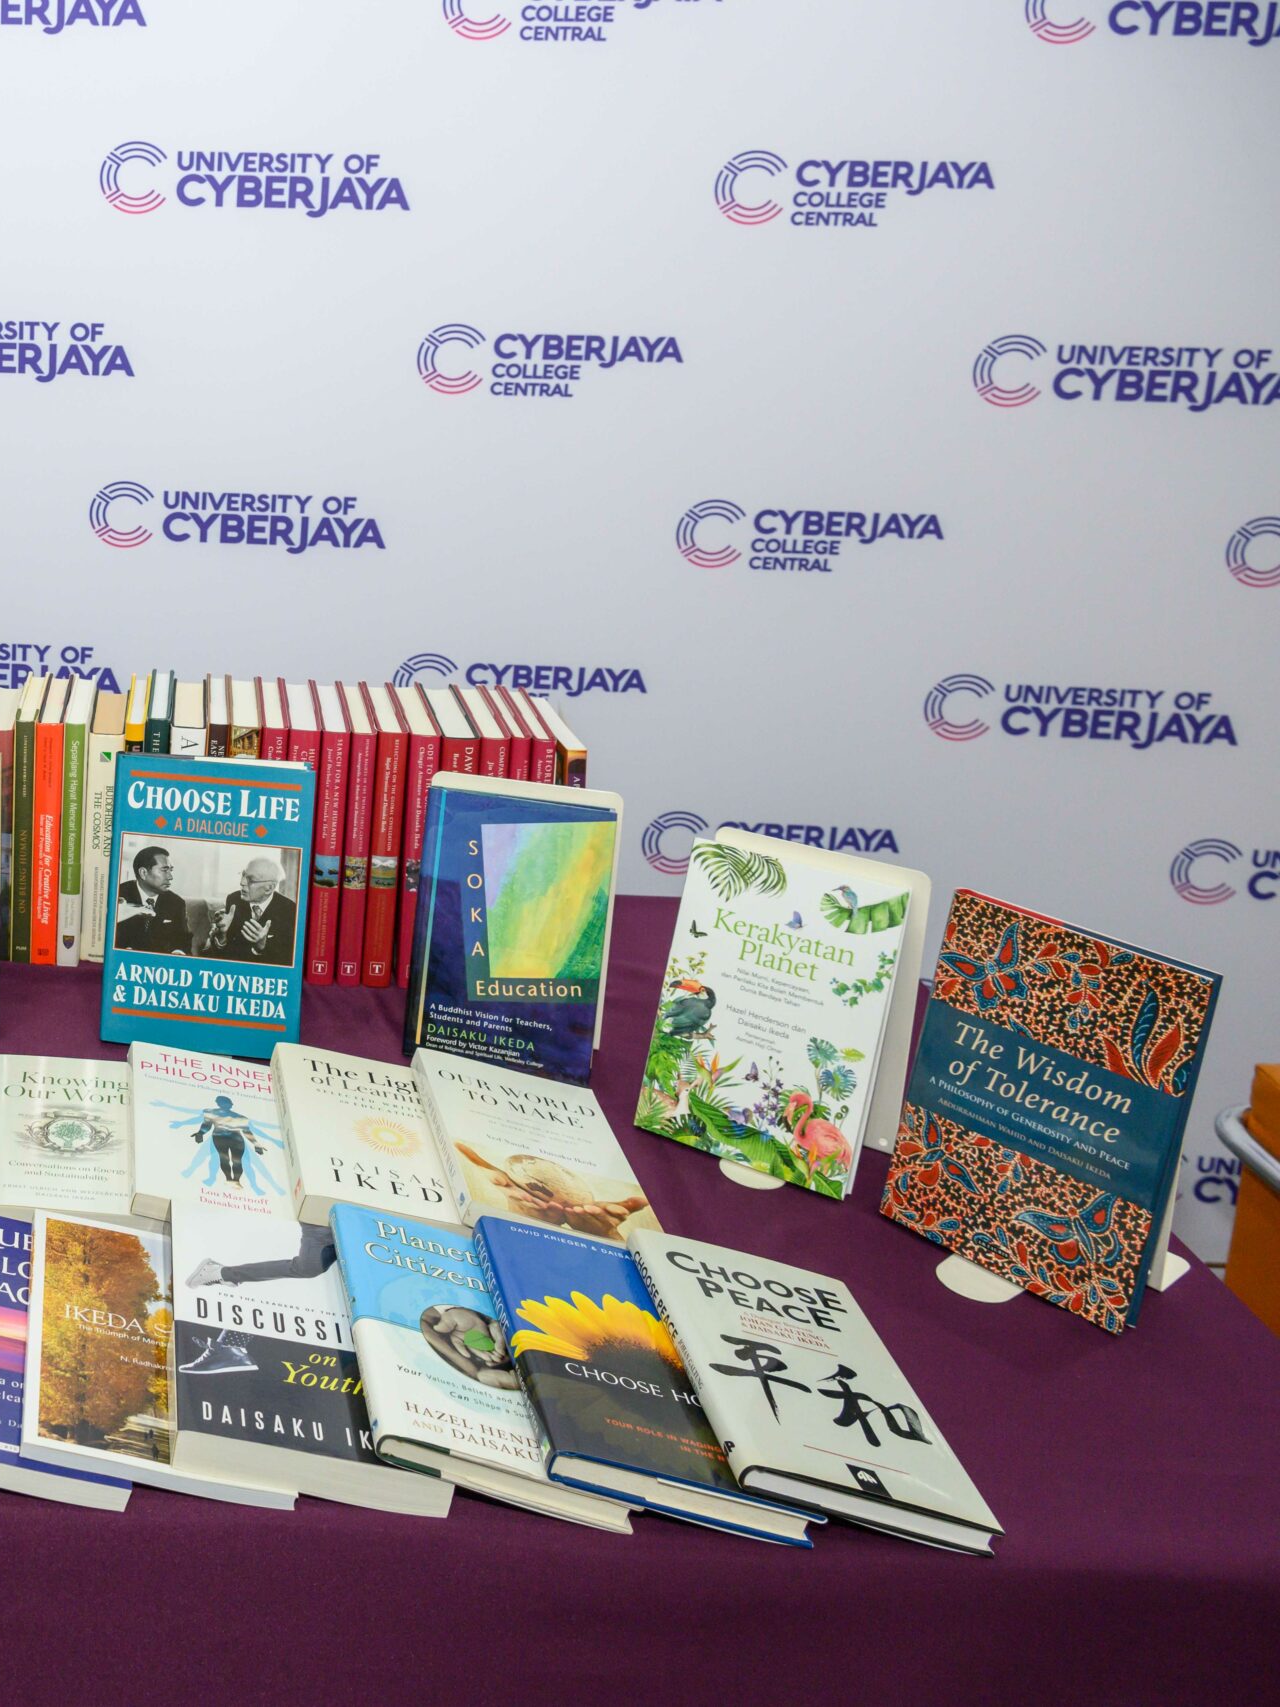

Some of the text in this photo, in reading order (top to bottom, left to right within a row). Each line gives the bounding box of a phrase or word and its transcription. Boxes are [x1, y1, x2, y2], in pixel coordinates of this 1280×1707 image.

[177, 151, 381, 176] UNIVERSITY OF
[795, 160, 995, 196] CYBERJAYA
[176, 174, 410, 218] CYBERJAYA
[792, 192, 886, 208] COLLEGE
[790, 211, 878, 227] CENTRAL
[69, 323, 104, 341] OF
[492, 333, 683, 370] CYBERJAYA
[1057, 345, 1272, 369] UNIVERSITY OF
[491, 364, 580, 380] COLLEGE
[490, 382, 573, 397] CENTRAL
[162, 490, 357, 515] UNIVERSITY OF
[162, 510, 386, 554] CYBERJAYA
[752, 509, 944, 545] CYBERJAYA
[751, 538, 840, 555] COLLEGE
[748, 557, 832, 572] CENTRAL
[60, 645, 94, 664] OF
[465, 663, 647, 697] CYBERJAYA
[1004, 684, 1212, 711] UNIVERSITY OF
[1001, 704, 1238, 749] CYBERJAYA
[127, 780, 301, 822] CHOOSE LIFE
[186, 818, 249, 838] DIALOGUE
[713, 907, 855, 967] Kerakyatan
[738, 939, 820, 982] Planet
[114, 961, 289, 997] ARNOLD TOYNBEE
[476, 980, 582, 998] Education
[133, 985, 286, 1019] DAISAKU IKEDA
[438, 1004, 499, 1021] Buddhist Vision
[429, 1012, 513, 1033] Students Parents
[726, 1003, 790, 1029] Hazel Henderson
[426, 1034, 457, 1046] Foreword
[427, 1023, 535, 1051] DAISAKU IKEDA
[160, 1052, 203, 1070] THE
[303, 1058, 358, 1080] The
[954, 1020, 1133, 1115] The Wisdom
[22, 1071, 129, 1092] Knowing
[438, 1069, 596, 1118] OUR WORLD
[463, 1088, 498, 1107] TO
[508, 1101, 584, 1130] MAKE
[948, 1058, 1120, 1144] of Tolerance
[938, 1079, 1131, 1172] PHILOSOPHY GENEROSITY AND PEACE
[200, 1196, 240, 1210] Daisaku
[510, 1225, 588, 1250] DAVID KRIEGER
[665, 1250, 849, 1315] CHOOSE
[695, 1276, 842, 1333] PEACE
[64, 1303, 146, 1335] IKEDA
[308, 1353, 338, 1368] on
[564, 1361, 664, 1399] CHOOSE
[202, 1400, 324, 1442] DAISAKU
[404, 1401, 474, 1431] HAZEL
[451, 1428, 541, 1463] DAISAKU
[636, 1425, 664, 1439] ROLE
